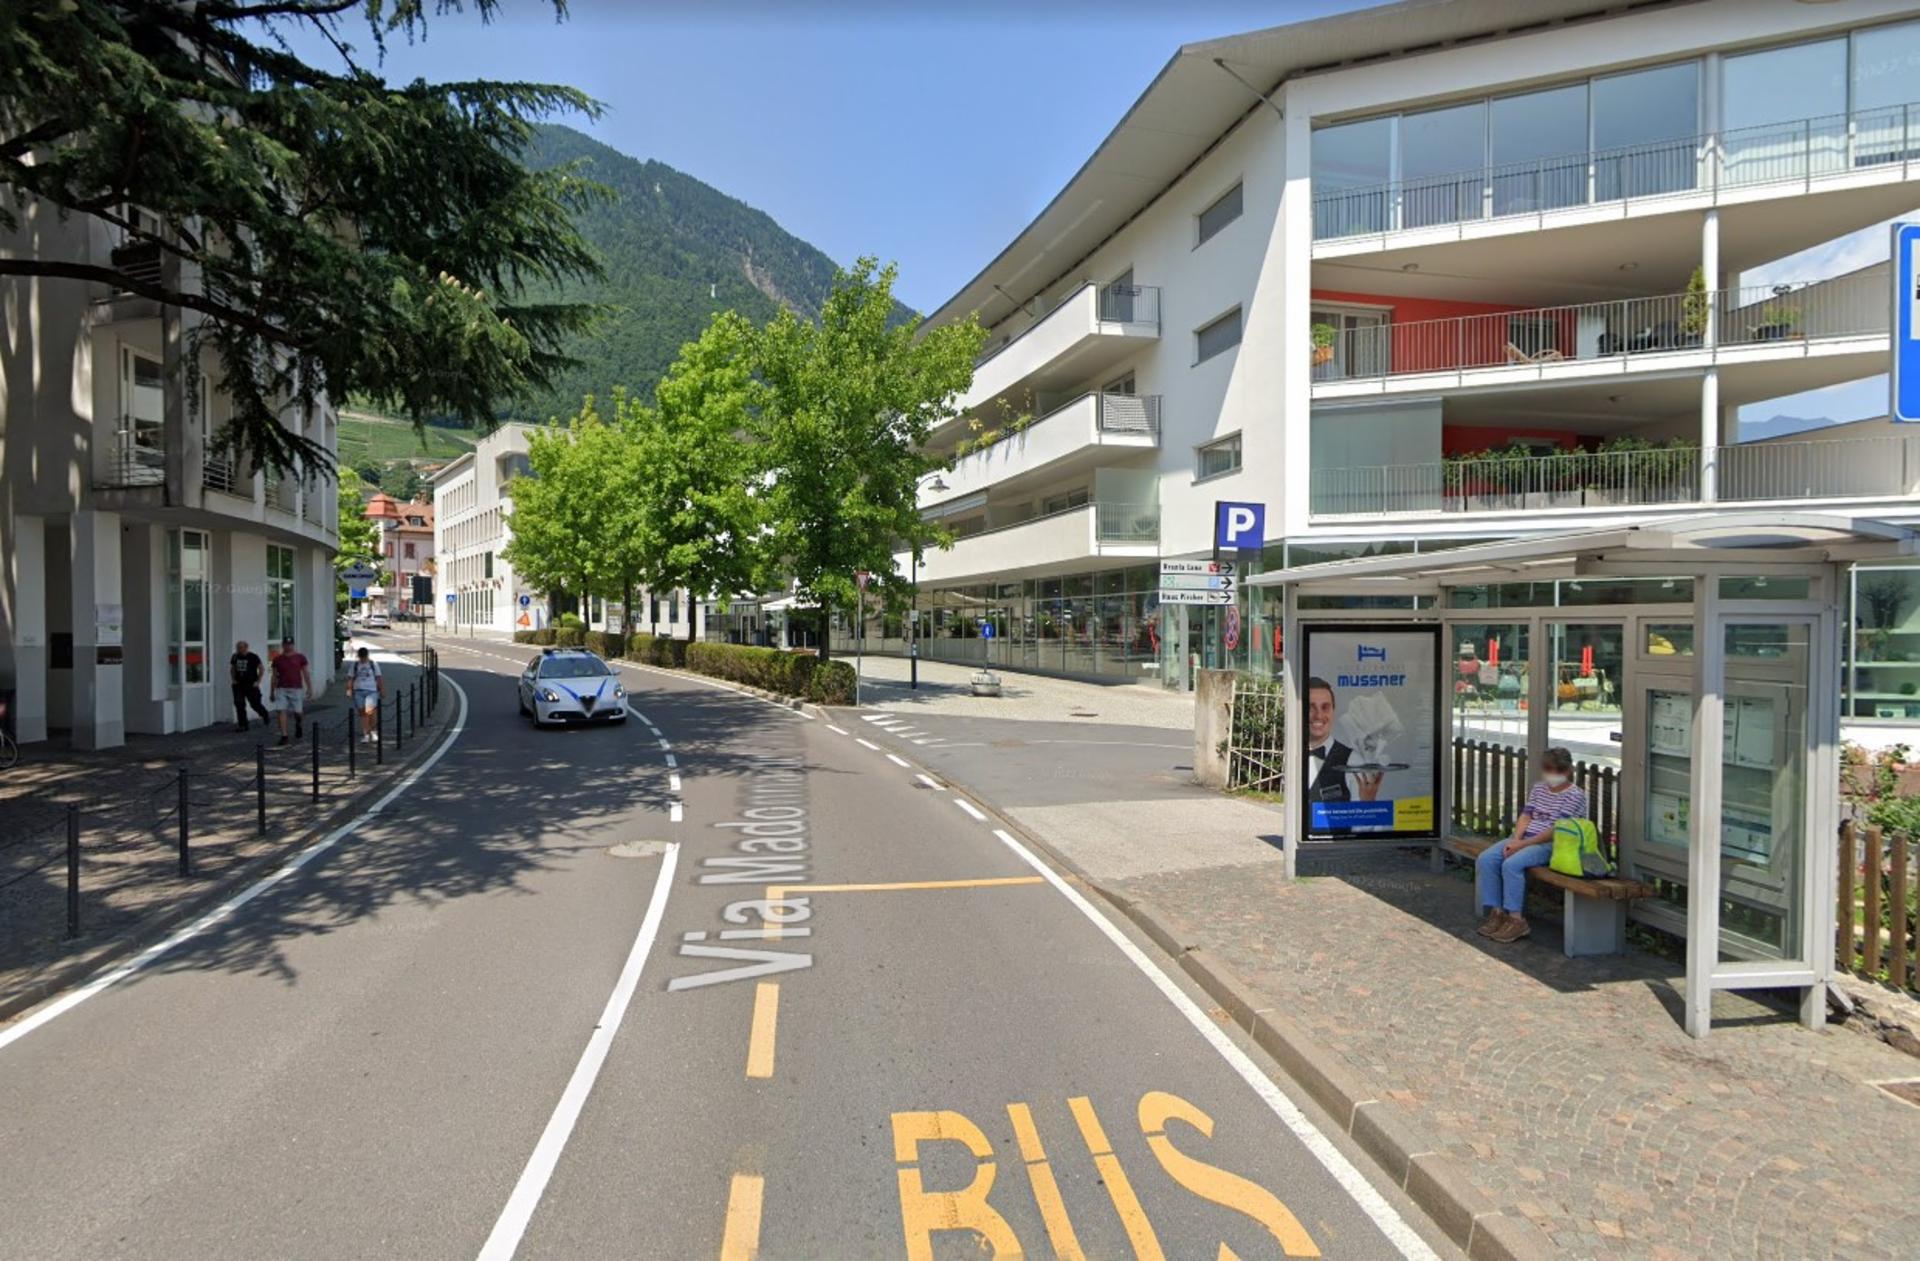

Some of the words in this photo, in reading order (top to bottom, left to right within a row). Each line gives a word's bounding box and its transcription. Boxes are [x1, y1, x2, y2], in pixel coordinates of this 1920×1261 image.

[1227, 507, 1256, 542] P
[1337, 674, 1406, 687] mussner
[891, 1091, 1322, 1261] BUS
